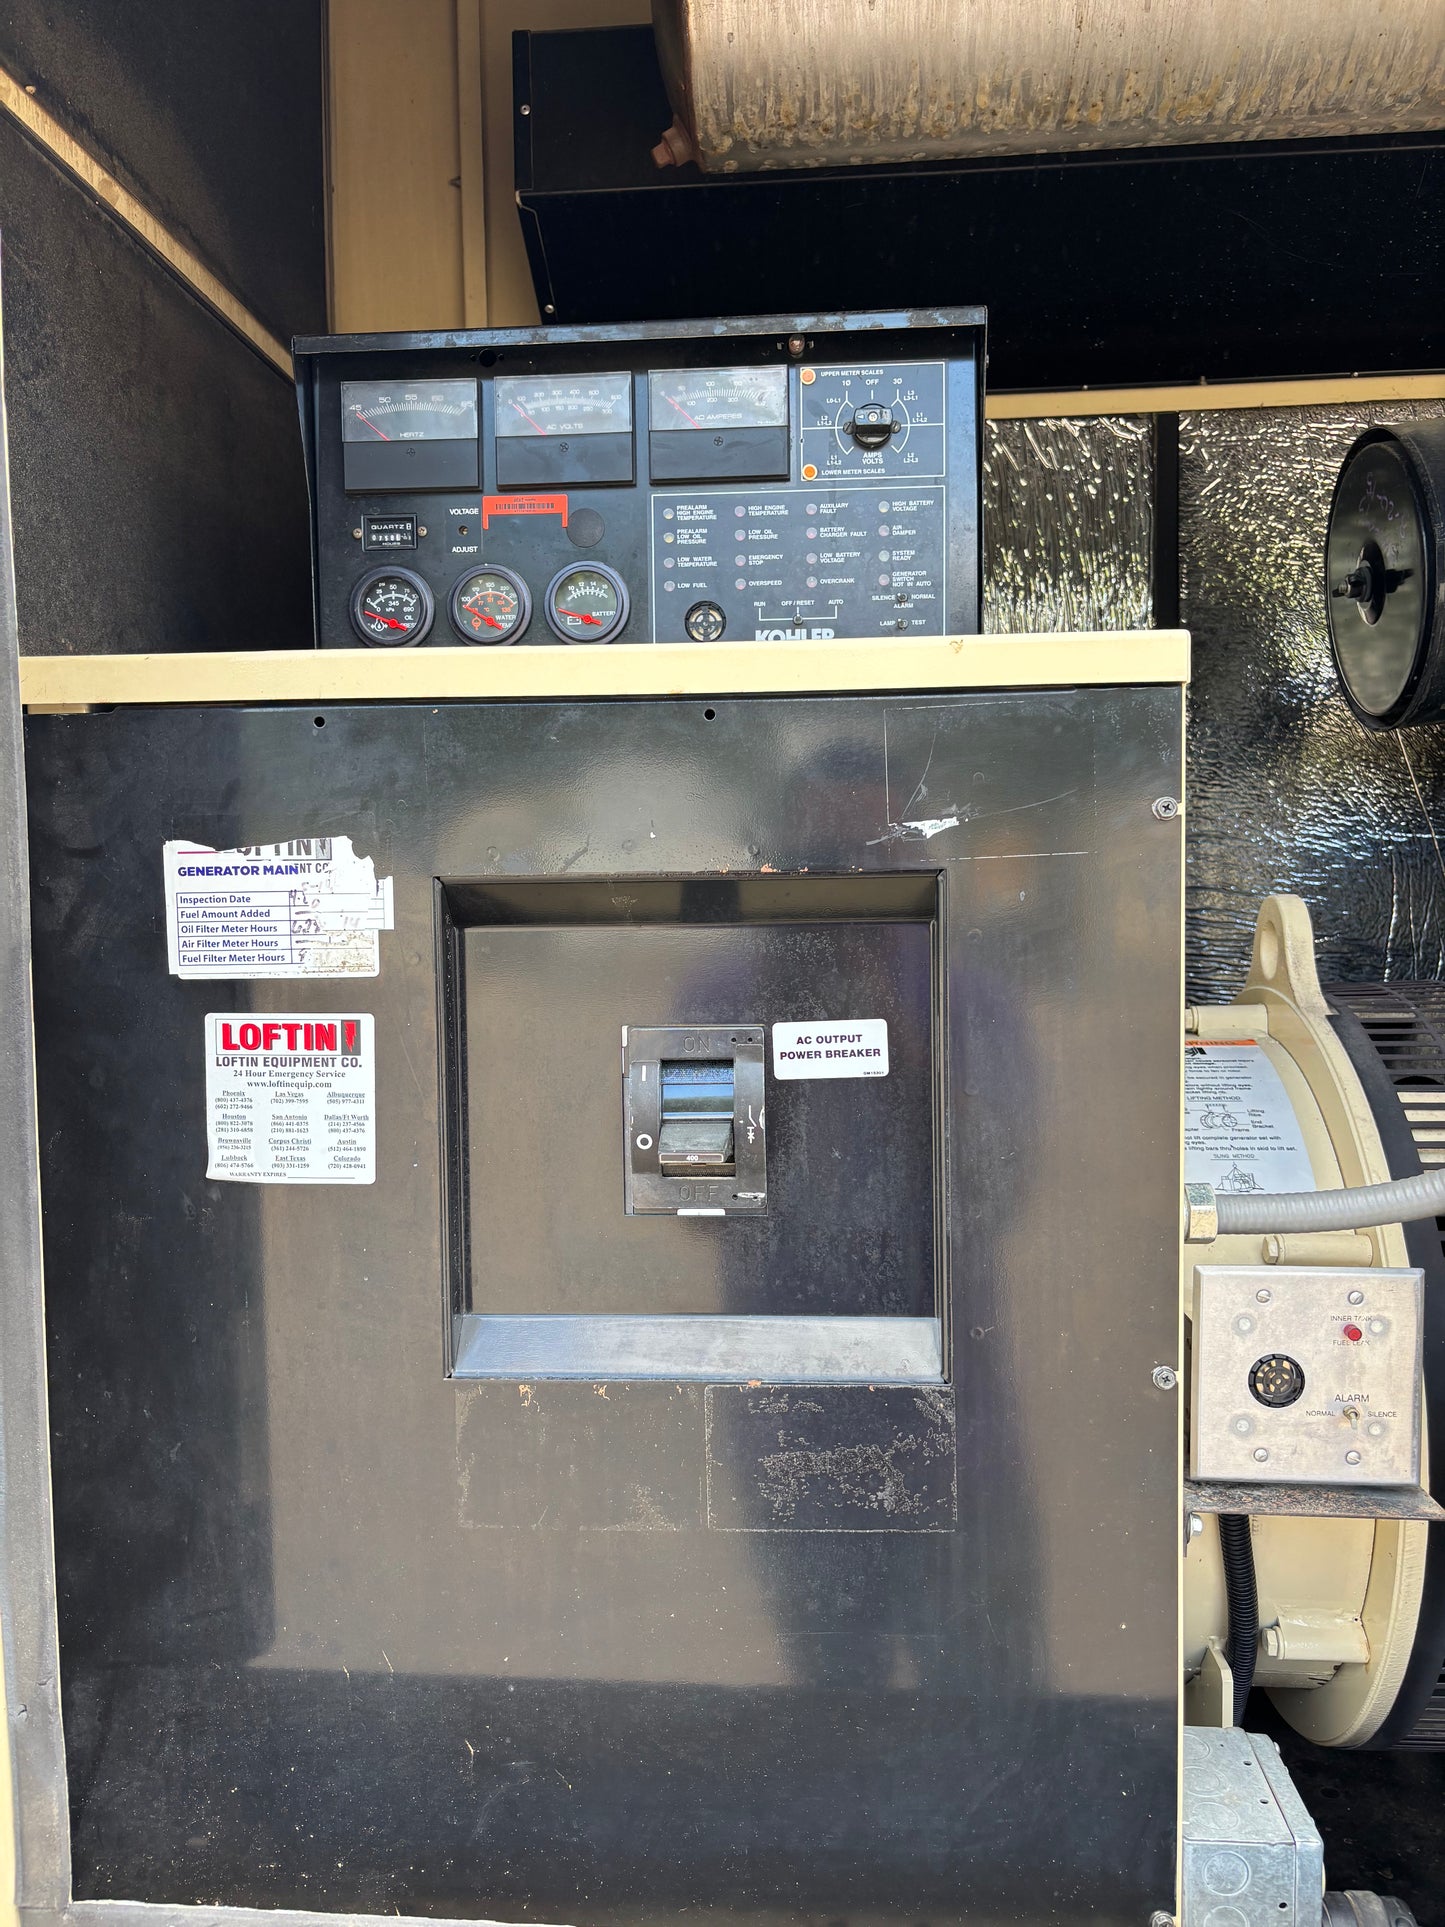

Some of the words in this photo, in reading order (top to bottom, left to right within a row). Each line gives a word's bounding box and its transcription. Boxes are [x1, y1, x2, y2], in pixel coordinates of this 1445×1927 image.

[178, 866, 260, 876] GENERATOR
[180, 895, 227, 905] Inspection
[181, 910, 199, 918] Fuel
[181, 925, 193, 933] Oil
[182, 954, 201, 962] Fuel
[222, 1023, 337, 1051] LOFTIN
[797, 1036, 812, 1045] AC
[816, 1034, 862, 1044] OUTPUT
[683, 1036, 710, 1053] ON
[780, 1051, 821, 1060] POWER
[825, 1048, 881, 1059] BREAKER
[216, 1057, 258, 1067] LOFTIN
[263, 1057, 336, 1068] EQUIPMENT
[341, 1057, 362, 1068] CO.
[269, 1070, 313, 1079] Emergency
[247, 1081, 331, 1089] www.loftinequip.com
[679, 1186, 719, 1201] OFF
[1335, 1394, 1370, 1402] ALARM
